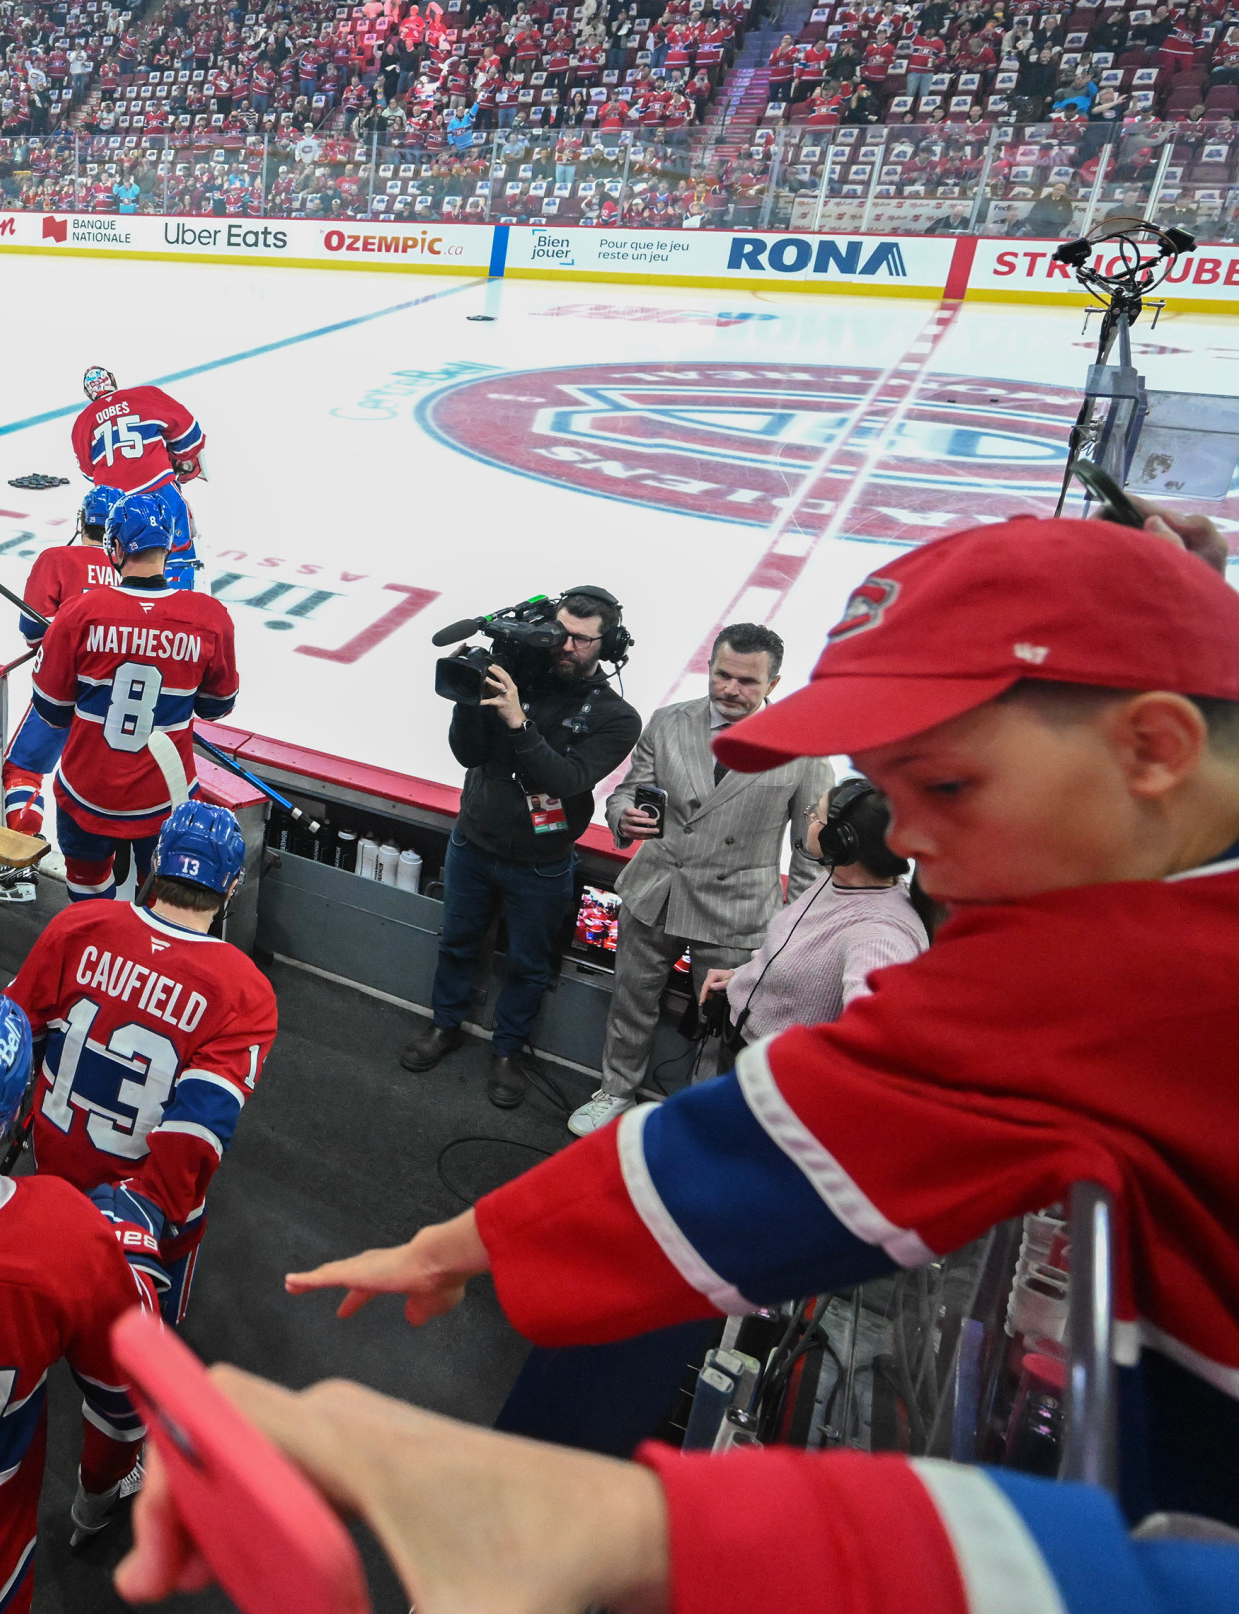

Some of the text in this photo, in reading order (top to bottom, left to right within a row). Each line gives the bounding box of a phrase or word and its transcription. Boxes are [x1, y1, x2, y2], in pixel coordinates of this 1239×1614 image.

[72, 218, 116, 230] BANQUE
[164, 222, 288, 249] Uber Eats
[72, 231, 131, 244] NATIONALE
[537, 235, 570, 248] Bien
[599, 239, 689, 252] Pour que le jeu
[531, 245, 571, 260] jouer
[598, 251, 669, 263] reste un jeu
[727, 237, 907, 277] RONA
[93, 414, 144, 468] 75
[87, 564, 123, 587] EVAN
[87, 625, 201, 663] MATHESON
[103, 661, 162, 753] 8
[182, 857, 200, 876] 13
[76, 946, 208, 1033] CAUFIELD
[41, 997, 179, 1161] 13
